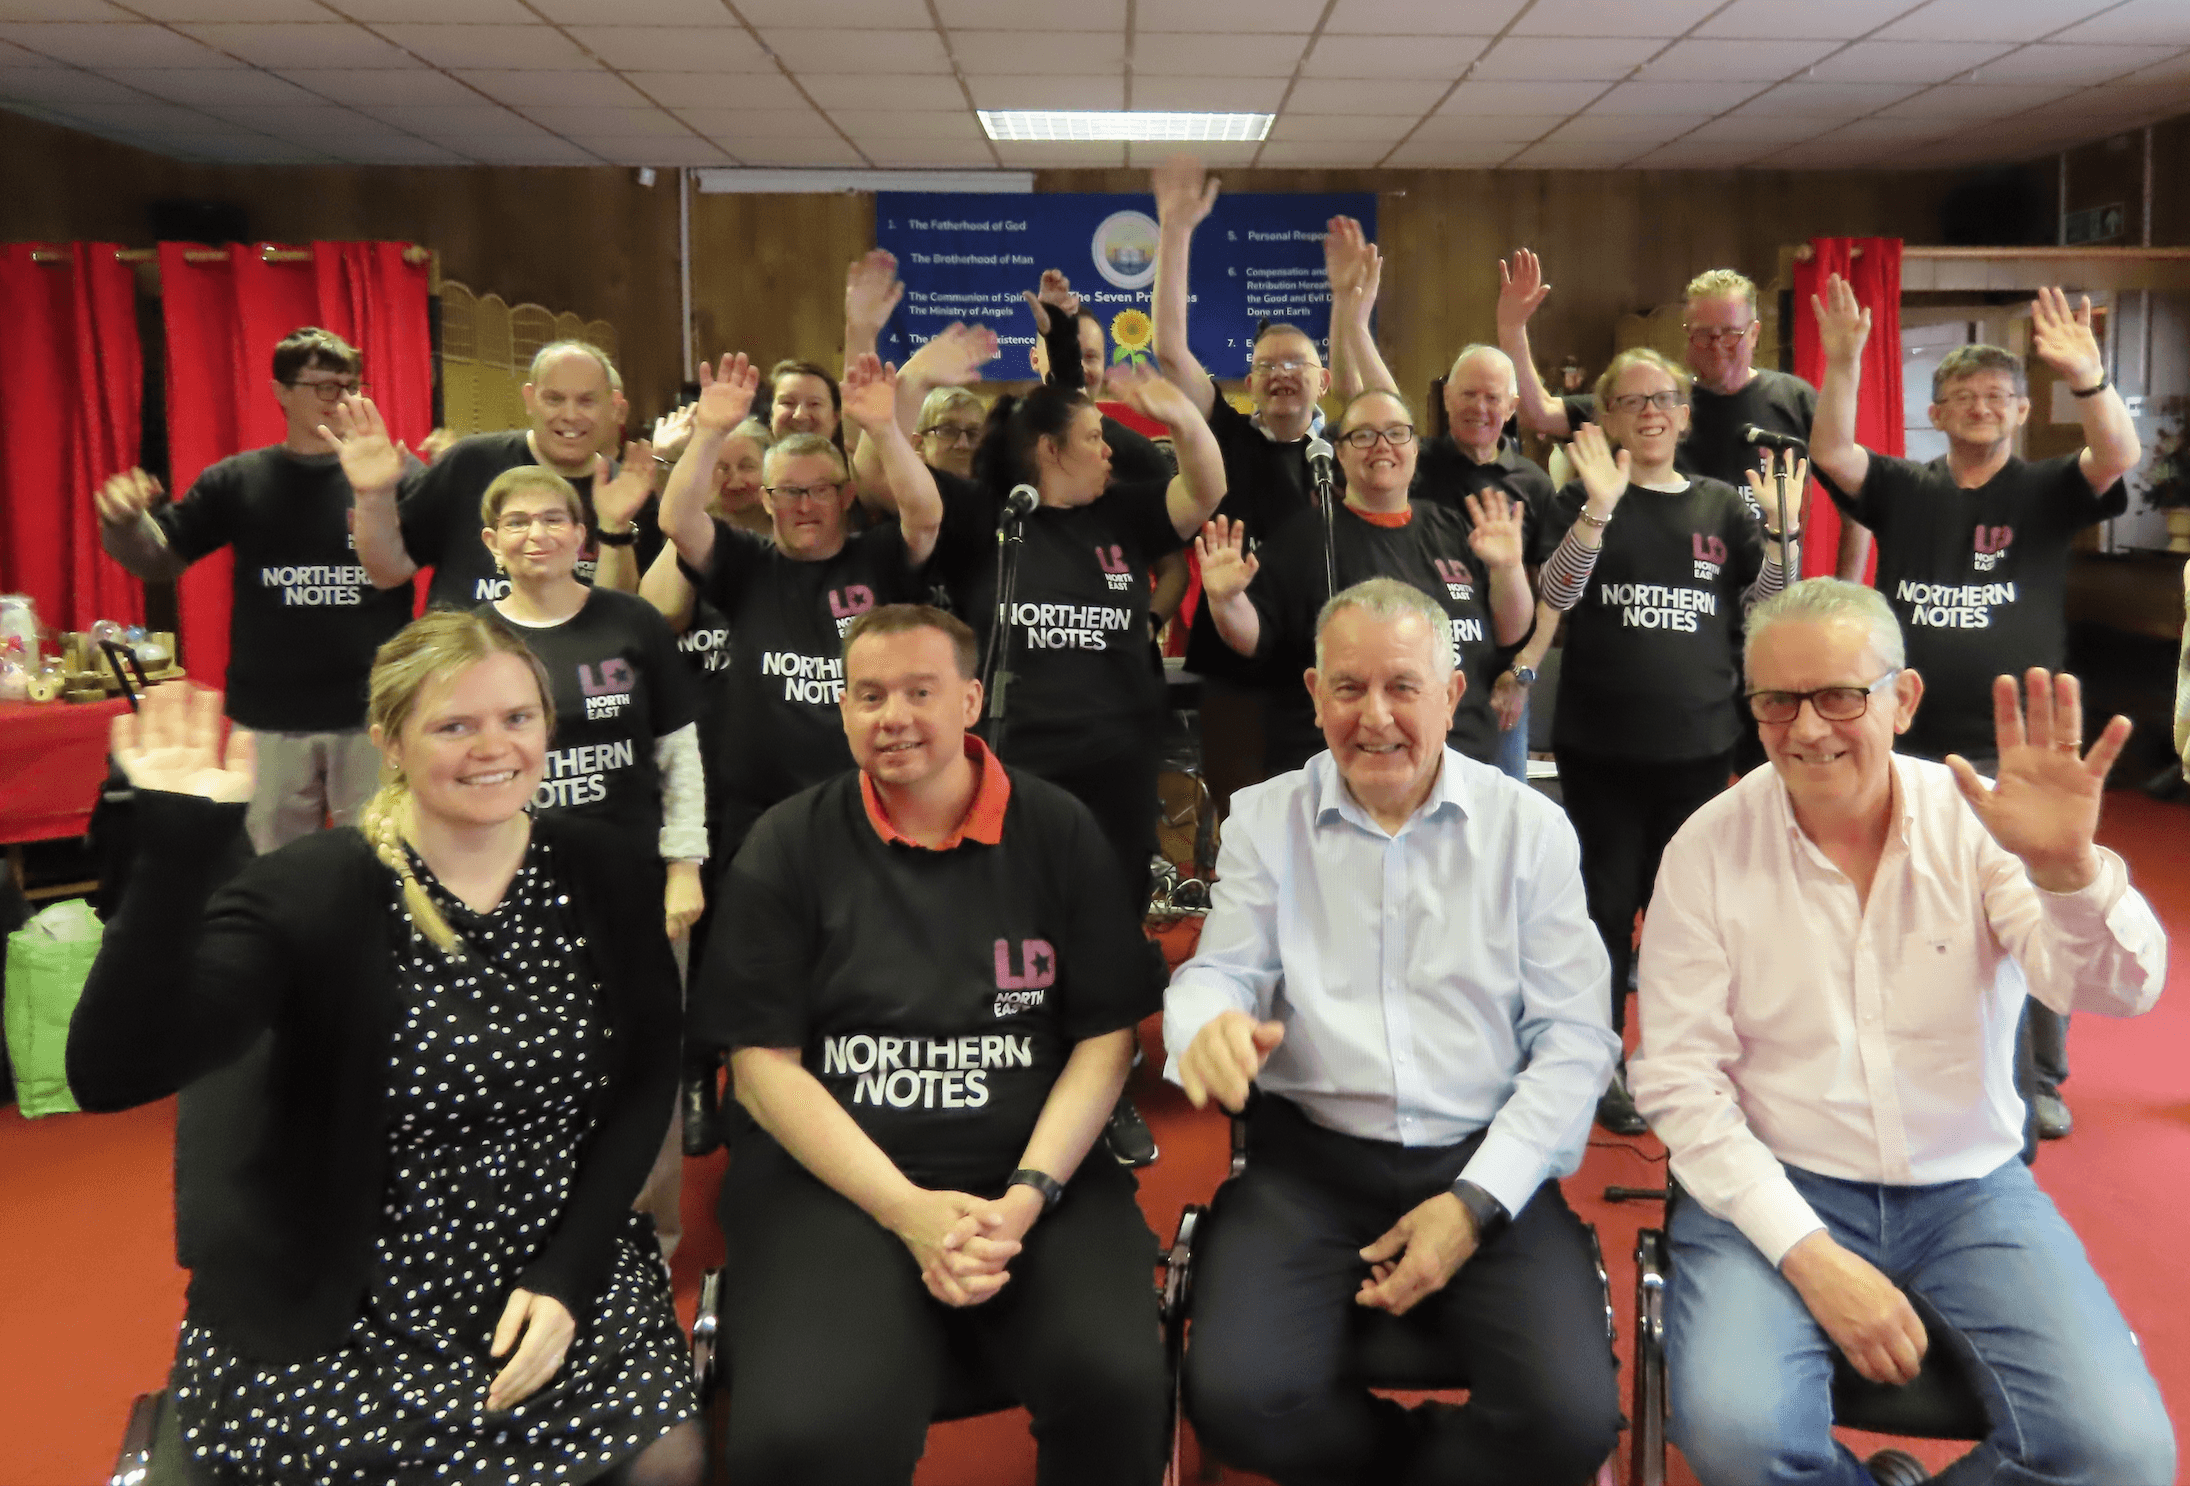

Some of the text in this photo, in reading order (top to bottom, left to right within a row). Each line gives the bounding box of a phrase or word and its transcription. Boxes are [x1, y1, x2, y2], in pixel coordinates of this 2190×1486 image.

[908, 219, 928, 230] The
[930, 219, 990, 231] Fatherhood
[992, 220, 1003, 231] of
[1005, 220, 1027, 231] God
[1228, 231, 1238, 241] 5.
[1248, 231, 1290, 242] Personal
[911, 253, 1035, 265] The Brotherhood of Man
[1228, 267, 1237, 276] 6.
[1246, 267, 1309, 278] Compensation
[1246, 281, 1297, 290] Retribution
[908, 292, 927, 302] The
[930, 292, 990, 302] Communion
[991, 293, 1001, 302] of
[1094, 291, 1132, 303] Seven
[1247, 294, 1261, 303] the
[1264, 294, 1287, 303] Good
[1290, 294, 1306, 302] and
[1308, 294, 1324, 302] Evil
[909, 306, 1014, 317] The Ministry of Angels
[1247, 307, 1271, 316] Done
[1286, 307, 1311, 316] Earth
[889, 334, 899, 343] 4.
[909, 334, 928, 344] The
[990, 335, 1036, 345] xistence
[1227, 338, 1236, 348] 7.
[260, 565, 373, 587] NORTHER
[1694, 560, 1720, 576] NORTH
[1694, 569, 1713, 581] EAST
[1105, 573, 1134, 583] NORTH
[1108, 581, 1129, 591] EAST
[284, 586, 362, 606] NOTES
[1450, 591, 1471, 601] EAST
[1601, 584, 1716, 617] NORTHERN
[1896, 580, 2016, 608] NORTHERN
[1623, 606, 1698, 633] NOTES
[1911, 604, 1990, 629] NOTES
[1028, 627, 1107, 651] NOTES
[762, 651, 844, 680] NORTH
[785, 677, 845, 705] NOTE
[584, 693, 631, 710] NORTH
[586, 705, 621, 721] EAST
[543, 739, 634, 779] THERN
[524, 773, 607, 813] OTES
[995, 990, 1045, 1006] NORTH
[824, 1034, 1034, 1075] NORTHERN
[853, 1067, 990, 1109] NOTES
